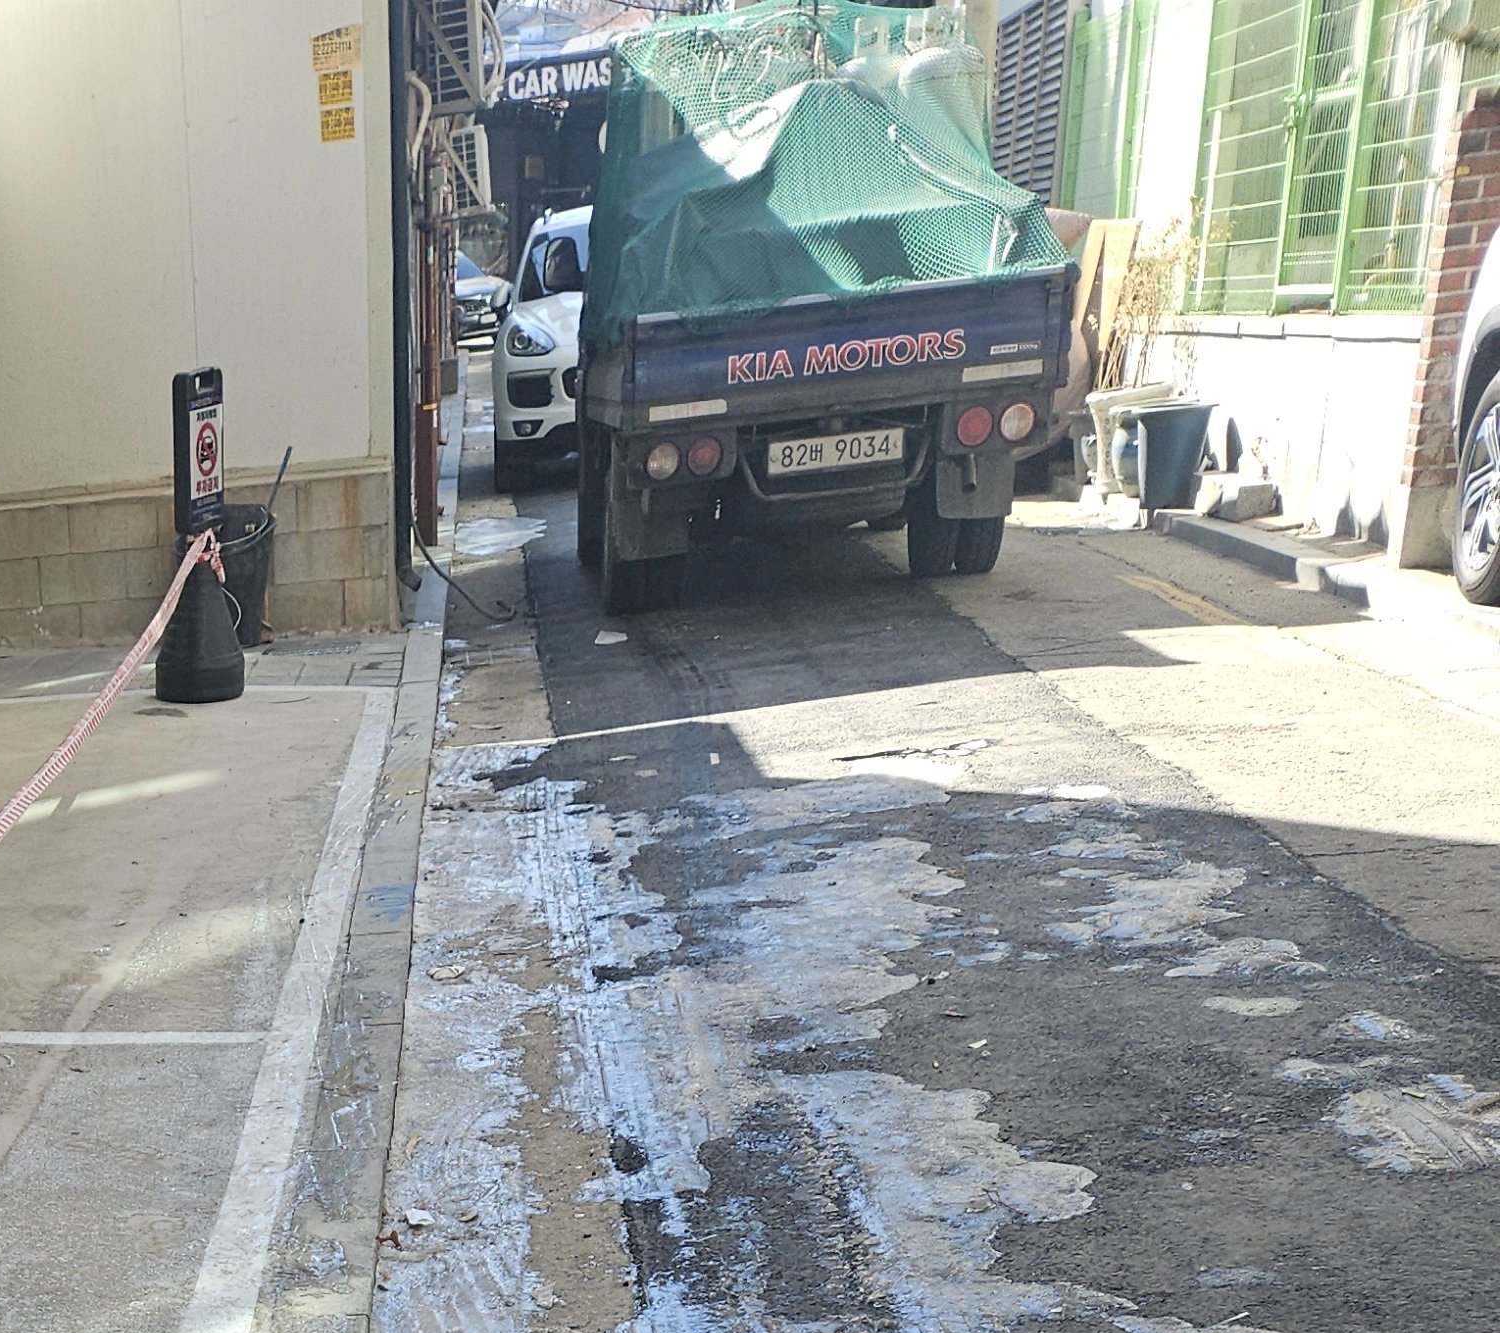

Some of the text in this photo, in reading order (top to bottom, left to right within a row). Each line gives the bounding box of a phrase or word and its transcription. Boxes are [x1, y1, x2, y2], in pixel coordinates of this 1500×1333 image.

[508, 66, 558, 100] CAR
[561, 57, 612, 92] WAS
[727, 328, 967, 384] KIA MOTORS
[780, 437, 891, 468] 82버 9034
